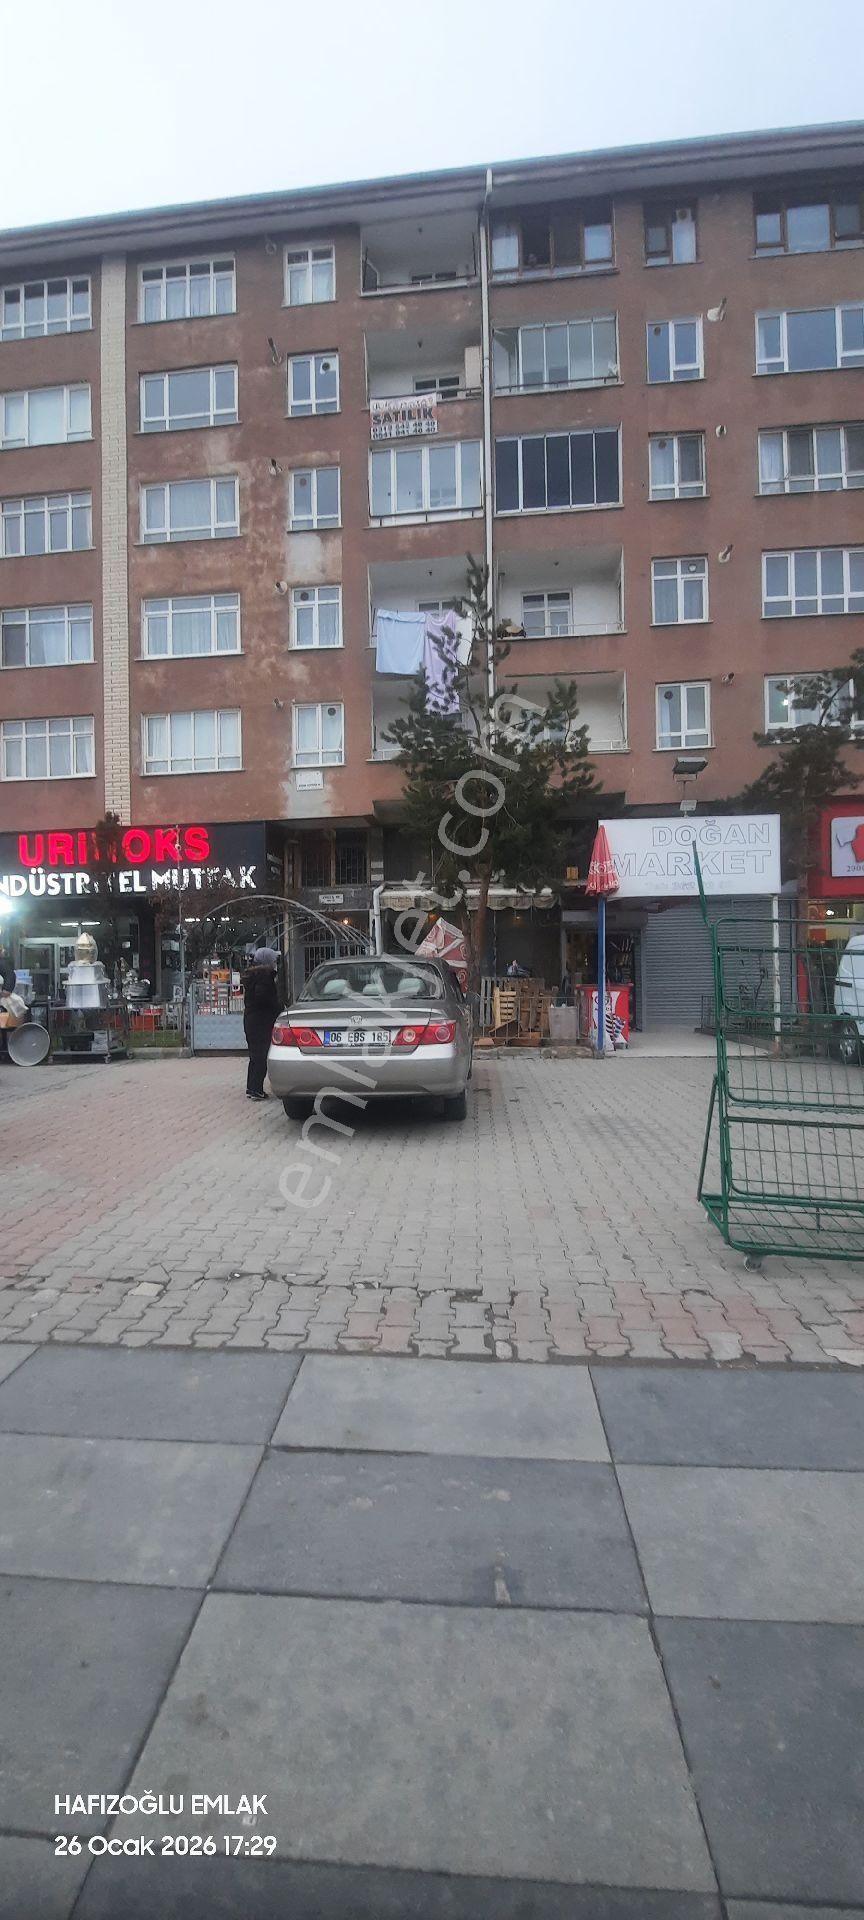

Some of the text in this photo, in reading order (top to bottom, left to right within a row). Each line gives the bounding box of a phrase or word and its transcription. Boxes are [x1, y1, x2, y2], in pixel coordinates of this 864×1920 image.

[372, 407, 434, 425] SATILIK
[652, 819, 770, 847] DOĞAN
[18, 827, 211, 868] URİOKS
[611, 849, 772, 876] MARKET
[330, 1031, 342, 1043] 06
[347, 1031, 366, 1043] EBS
